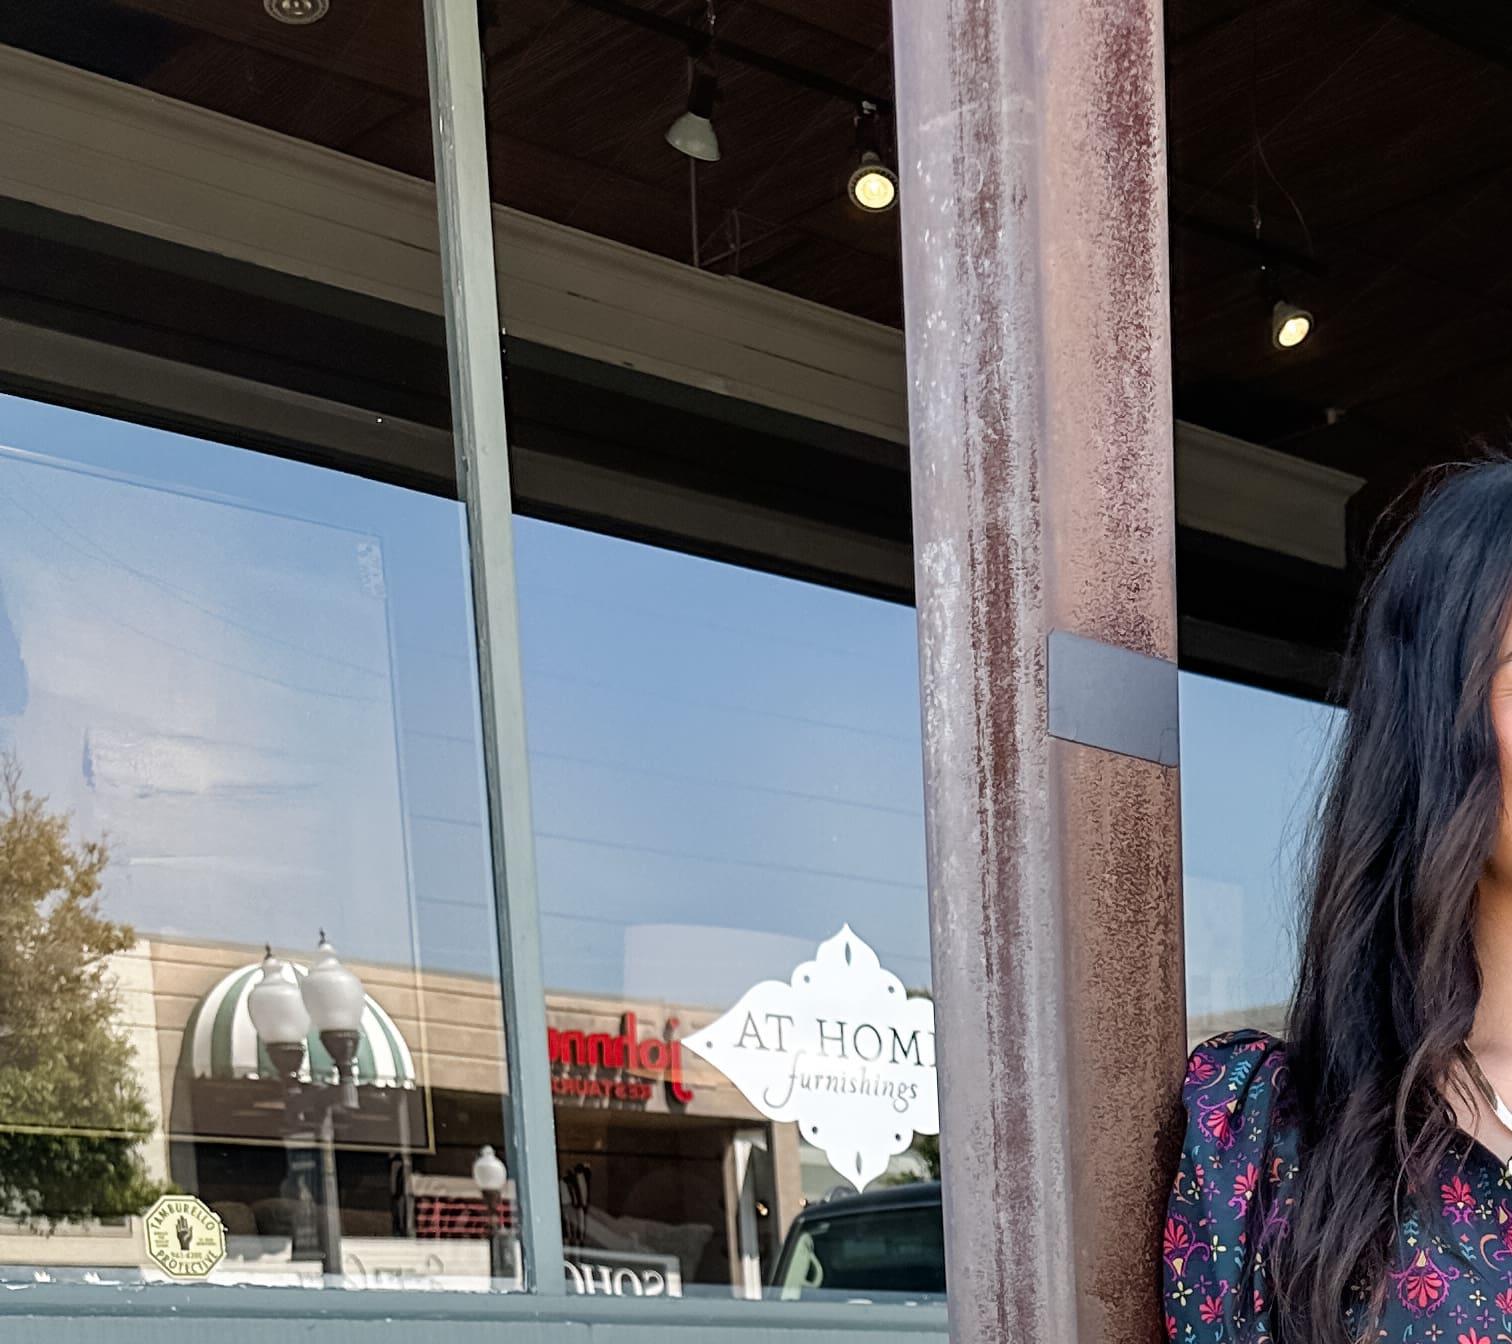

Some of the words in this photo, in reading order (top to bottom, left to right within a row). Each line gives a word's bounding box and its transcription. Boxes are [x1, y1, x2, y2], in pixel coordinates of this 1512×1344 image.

[734, 1010, 795, 1053] AT
[815, 1018, 936, 1068] HOM
[763, 1049, 919, 1113] furnishings
[150, 1202, 216, 1231] TAMBURELLO
[156, 1249, 218, 1274] PROTECTIVE
